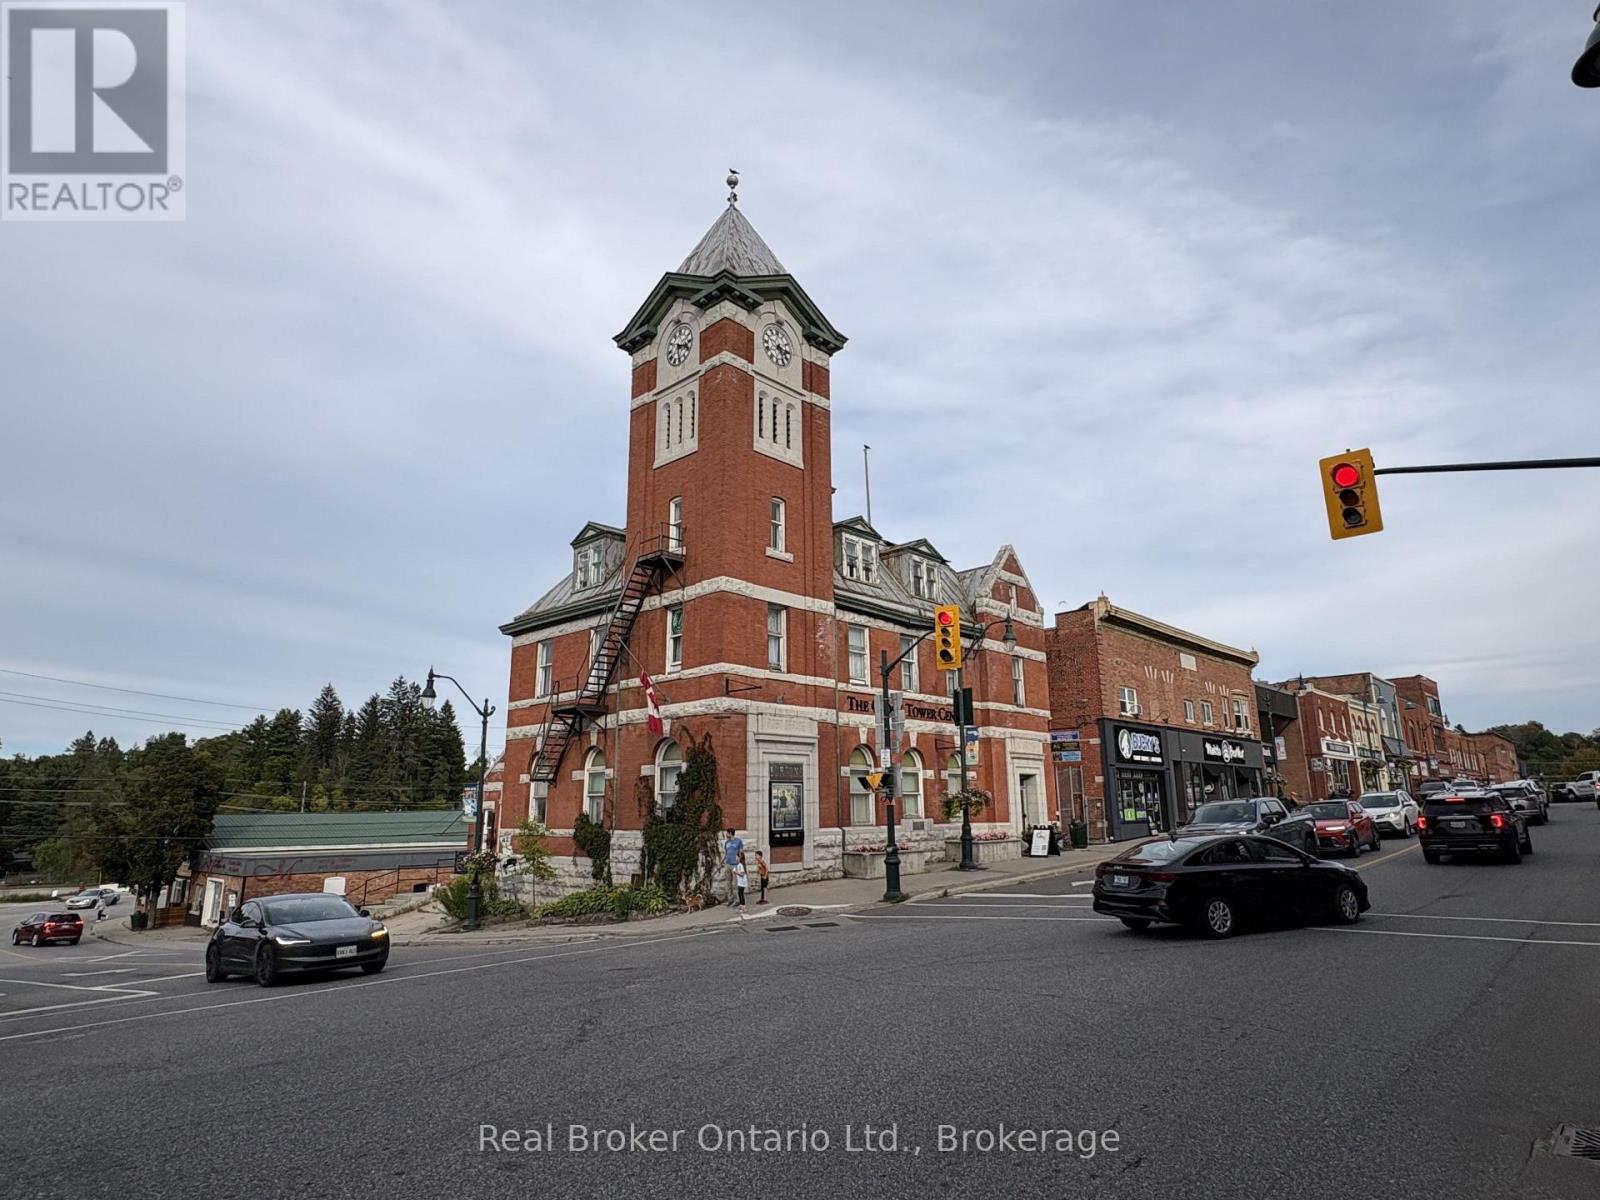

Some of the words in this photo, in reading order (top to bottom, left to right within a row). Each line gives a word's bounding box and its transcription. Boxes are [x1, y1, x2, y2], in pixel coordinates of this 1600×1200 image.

[846, 695, 870, 713] THE
[905, 703, 937, 721] TOWER
[938, 707, 955, 721] CEN
